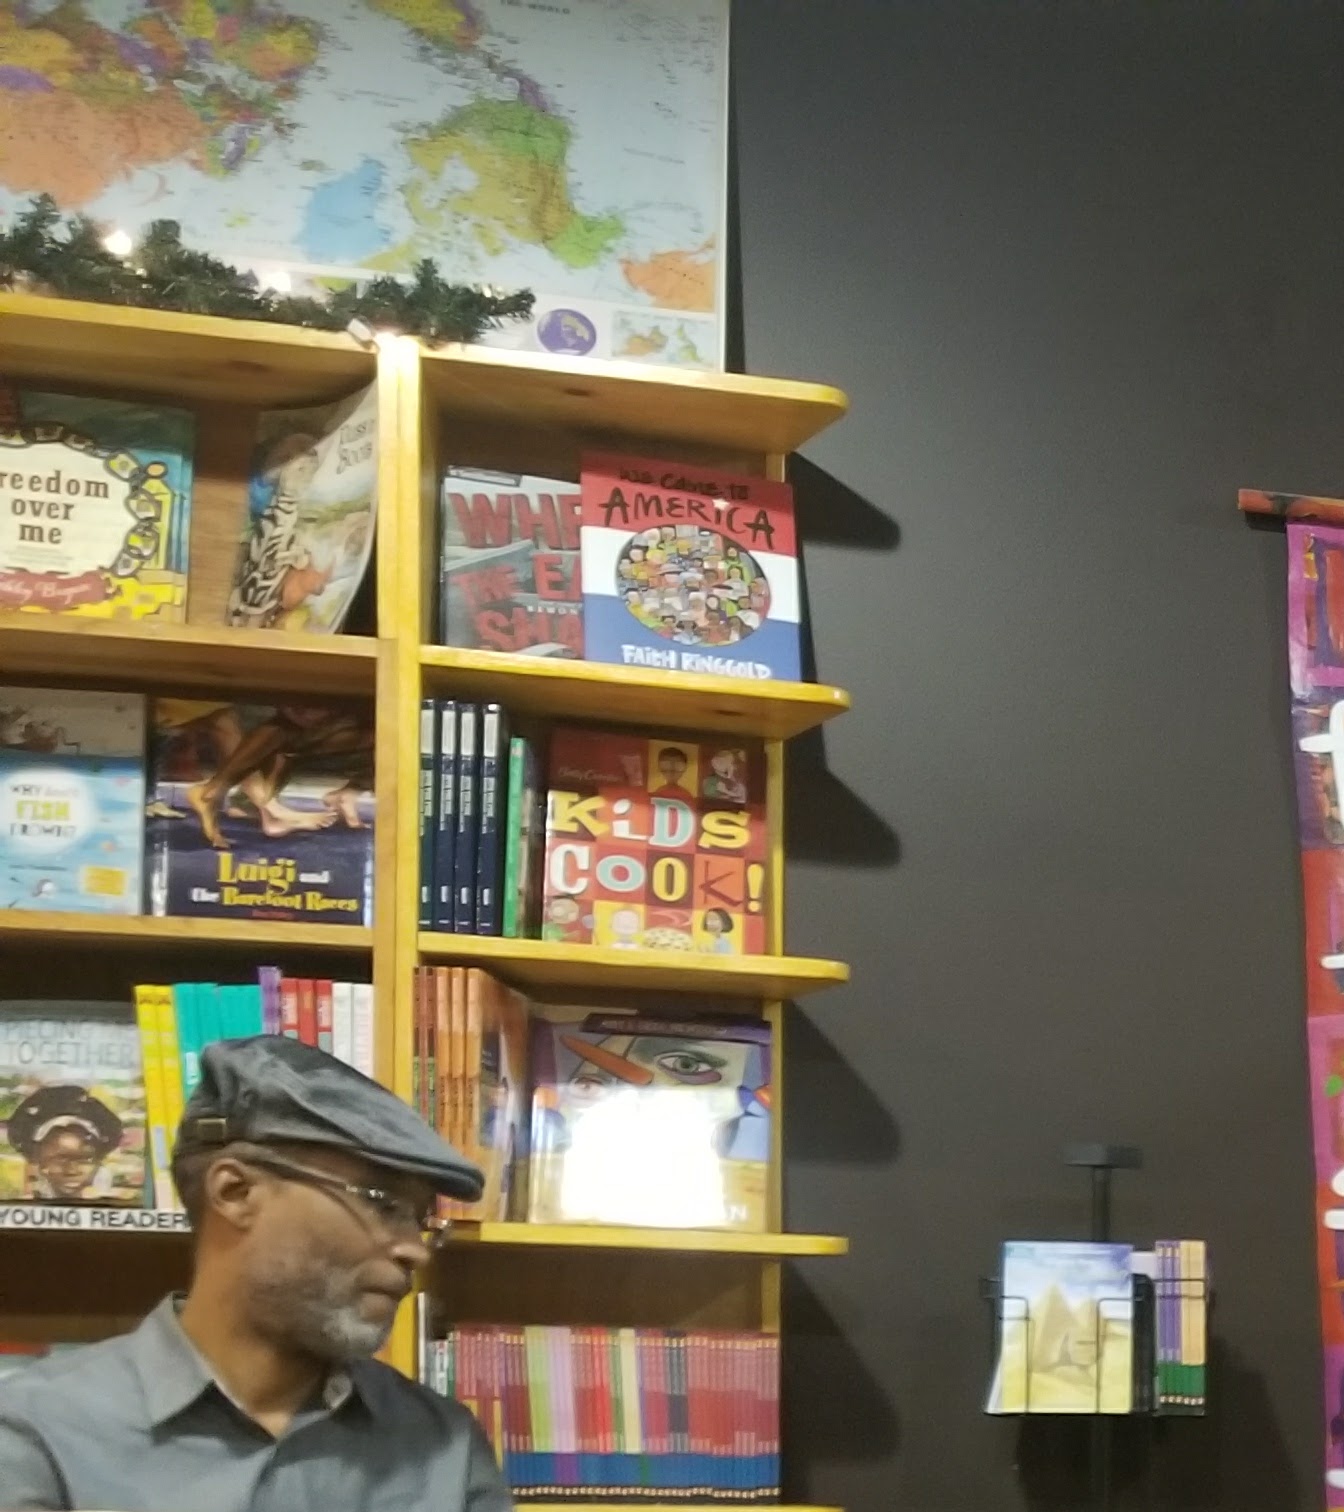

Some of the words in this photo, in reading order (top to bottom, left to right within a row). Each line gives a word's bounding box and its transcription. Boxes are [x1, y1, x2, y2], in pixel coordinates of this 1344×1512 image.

[0, 470, 110, 499] reedom
[11, 498, 75, 520] over
[447, 493, 583, 549] WHE
[598, 486, 775, 550] AMERICA
[18, 523, 63, 544] me
[475, 606, 585, 657] SHA
[681, 651, 772, 680] RINGGOLD
[216, 851, 297, 896] Luigi
[549, 844, 765, 912] COOK!
[0, 1208, 82, 1226] YOUNG
[90, 1211, 190, 1230] READER
